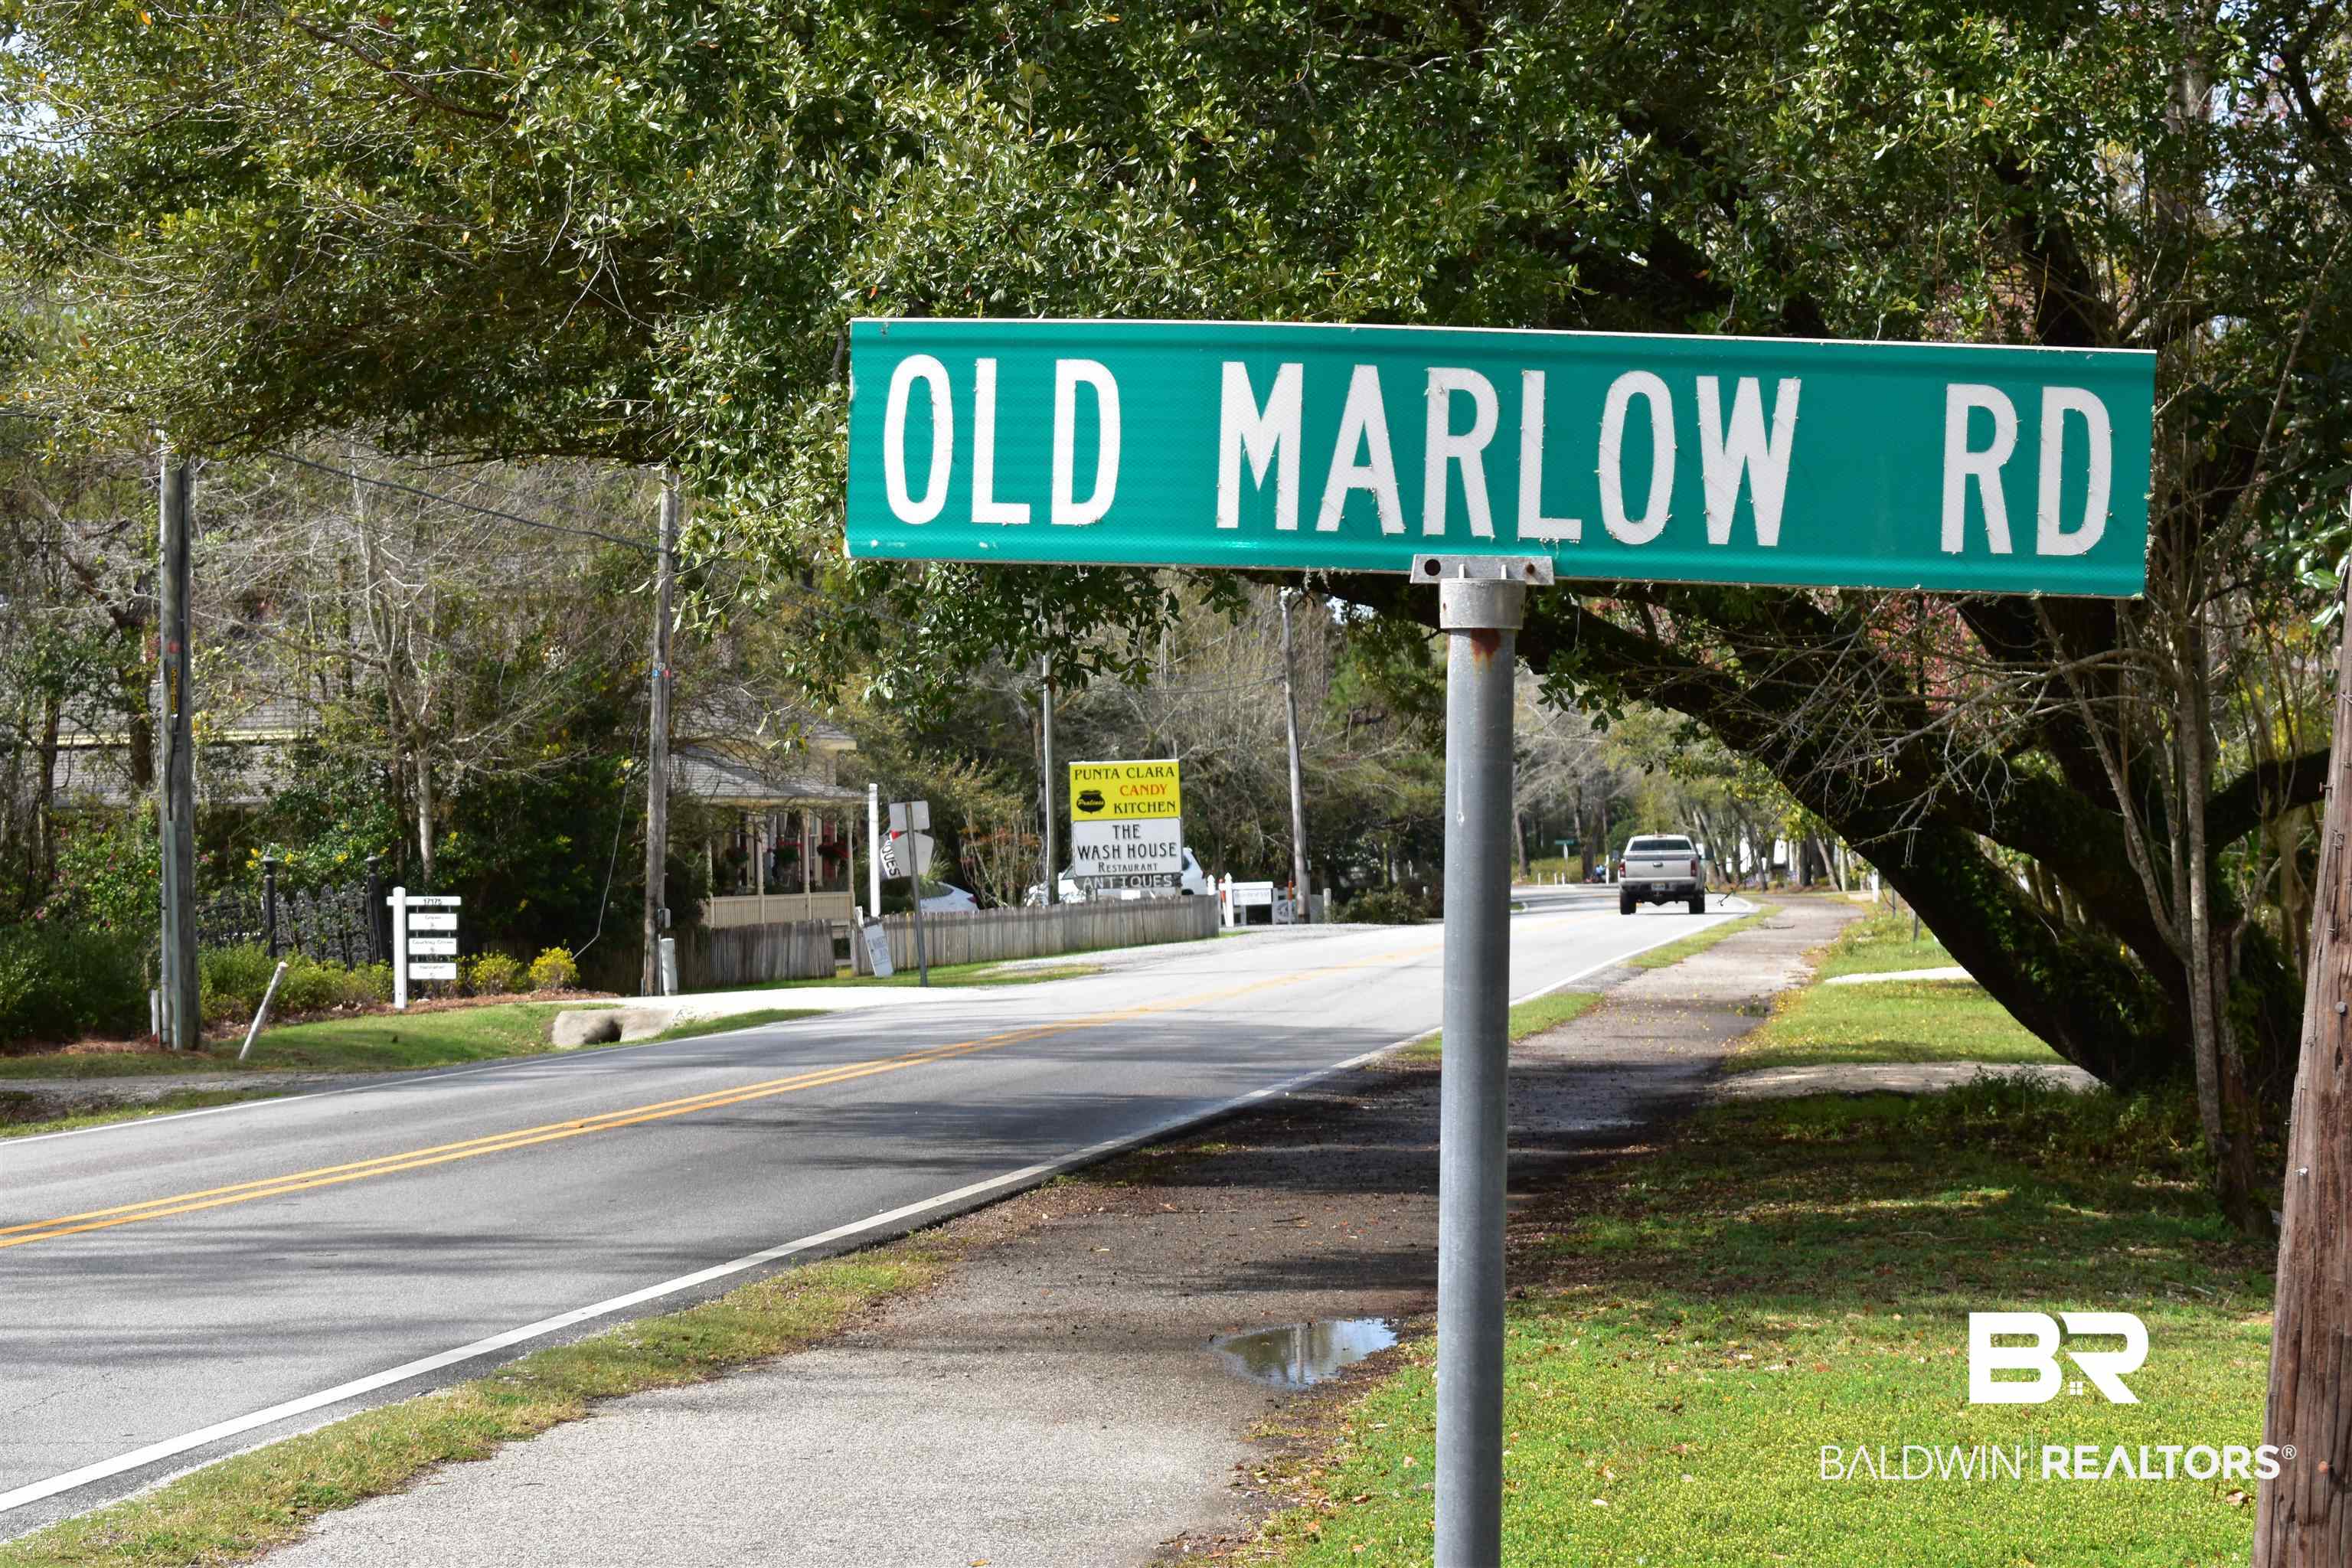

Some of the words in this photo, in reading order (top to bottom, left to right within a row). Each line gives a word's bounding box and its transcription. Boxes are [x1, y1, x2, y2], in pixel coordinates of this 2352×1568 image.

[884, 354, 1121, 525] OLD
[1216, 361, 1802, 547] MARLOW
[1941, 383, 2113, 556] RD
[1074, 768, 1120, 780] PUNTA
[1126, 766, 1174, 779] CLARA
[1119, 784, 1168, 796] CANDY
[1114, 801, 1176, 814] KITCHEN
[1112, 824, 1141, 839] THE
[1077, 844, 1120, 860] WASH
[1127, 842, 1177, 858] HOUSE
[881, 844, 902, 876] QUES
[1083, 874, 1173, 889] ANTIQUES
